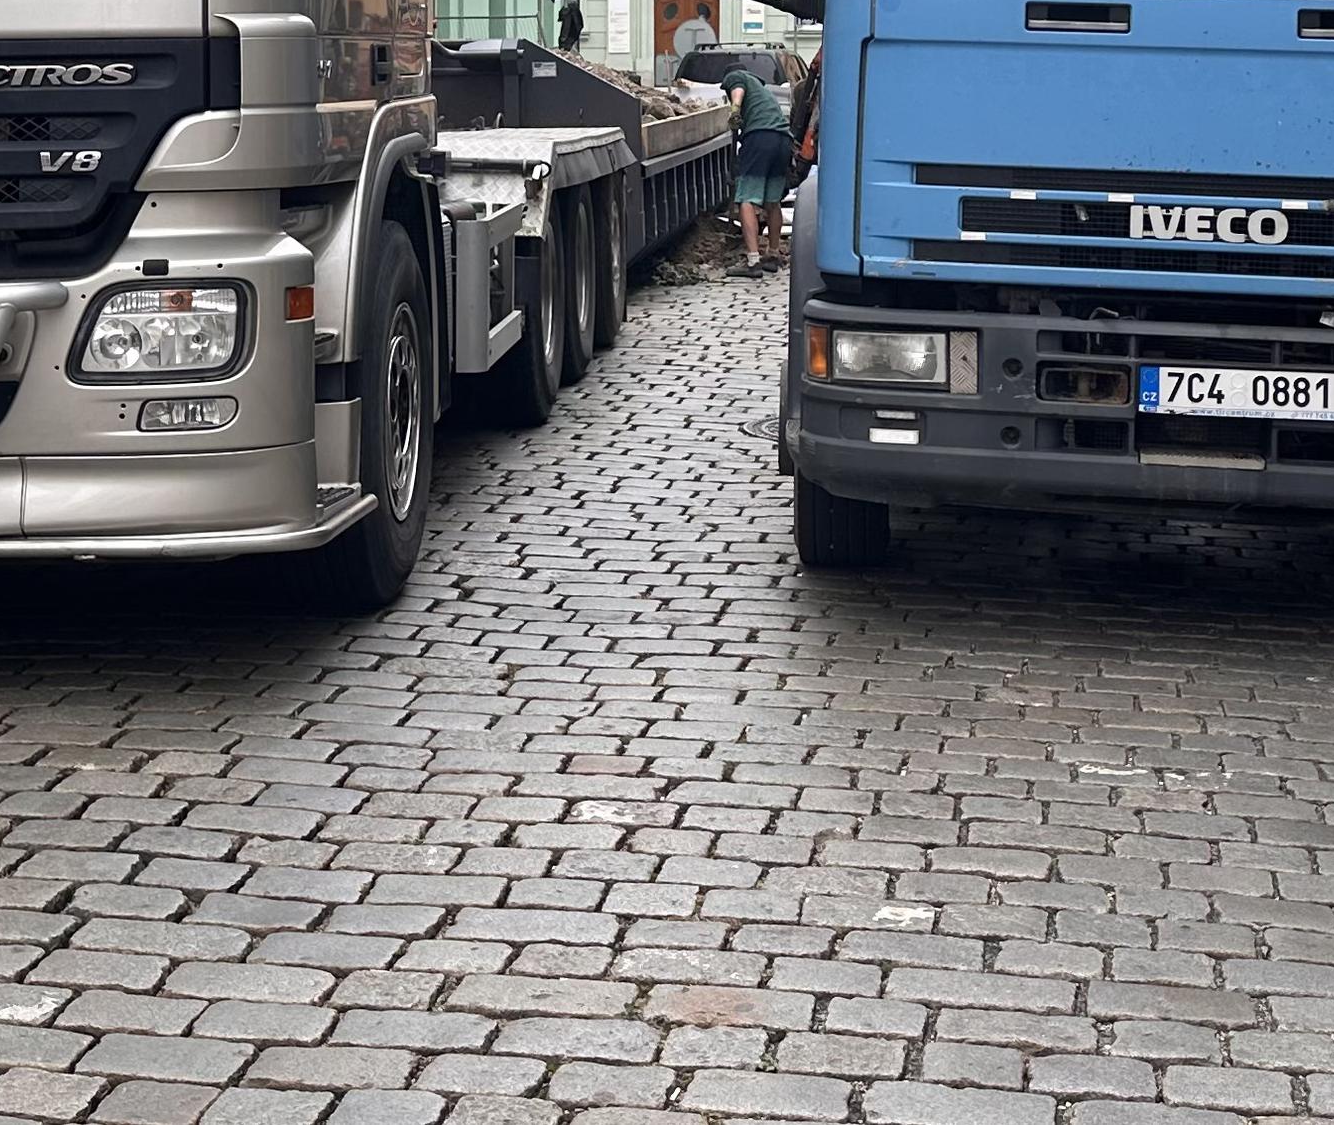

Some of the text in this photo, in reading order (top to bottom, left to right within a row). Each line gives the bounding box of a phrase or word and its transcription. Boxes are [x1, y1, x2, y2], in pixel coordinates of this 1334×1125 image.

[39, 150, 102, 173] V8
[1129, 204, 1289, 245] IVECO
[1142, 371, 1330, 409] CZ 7C4 0881
